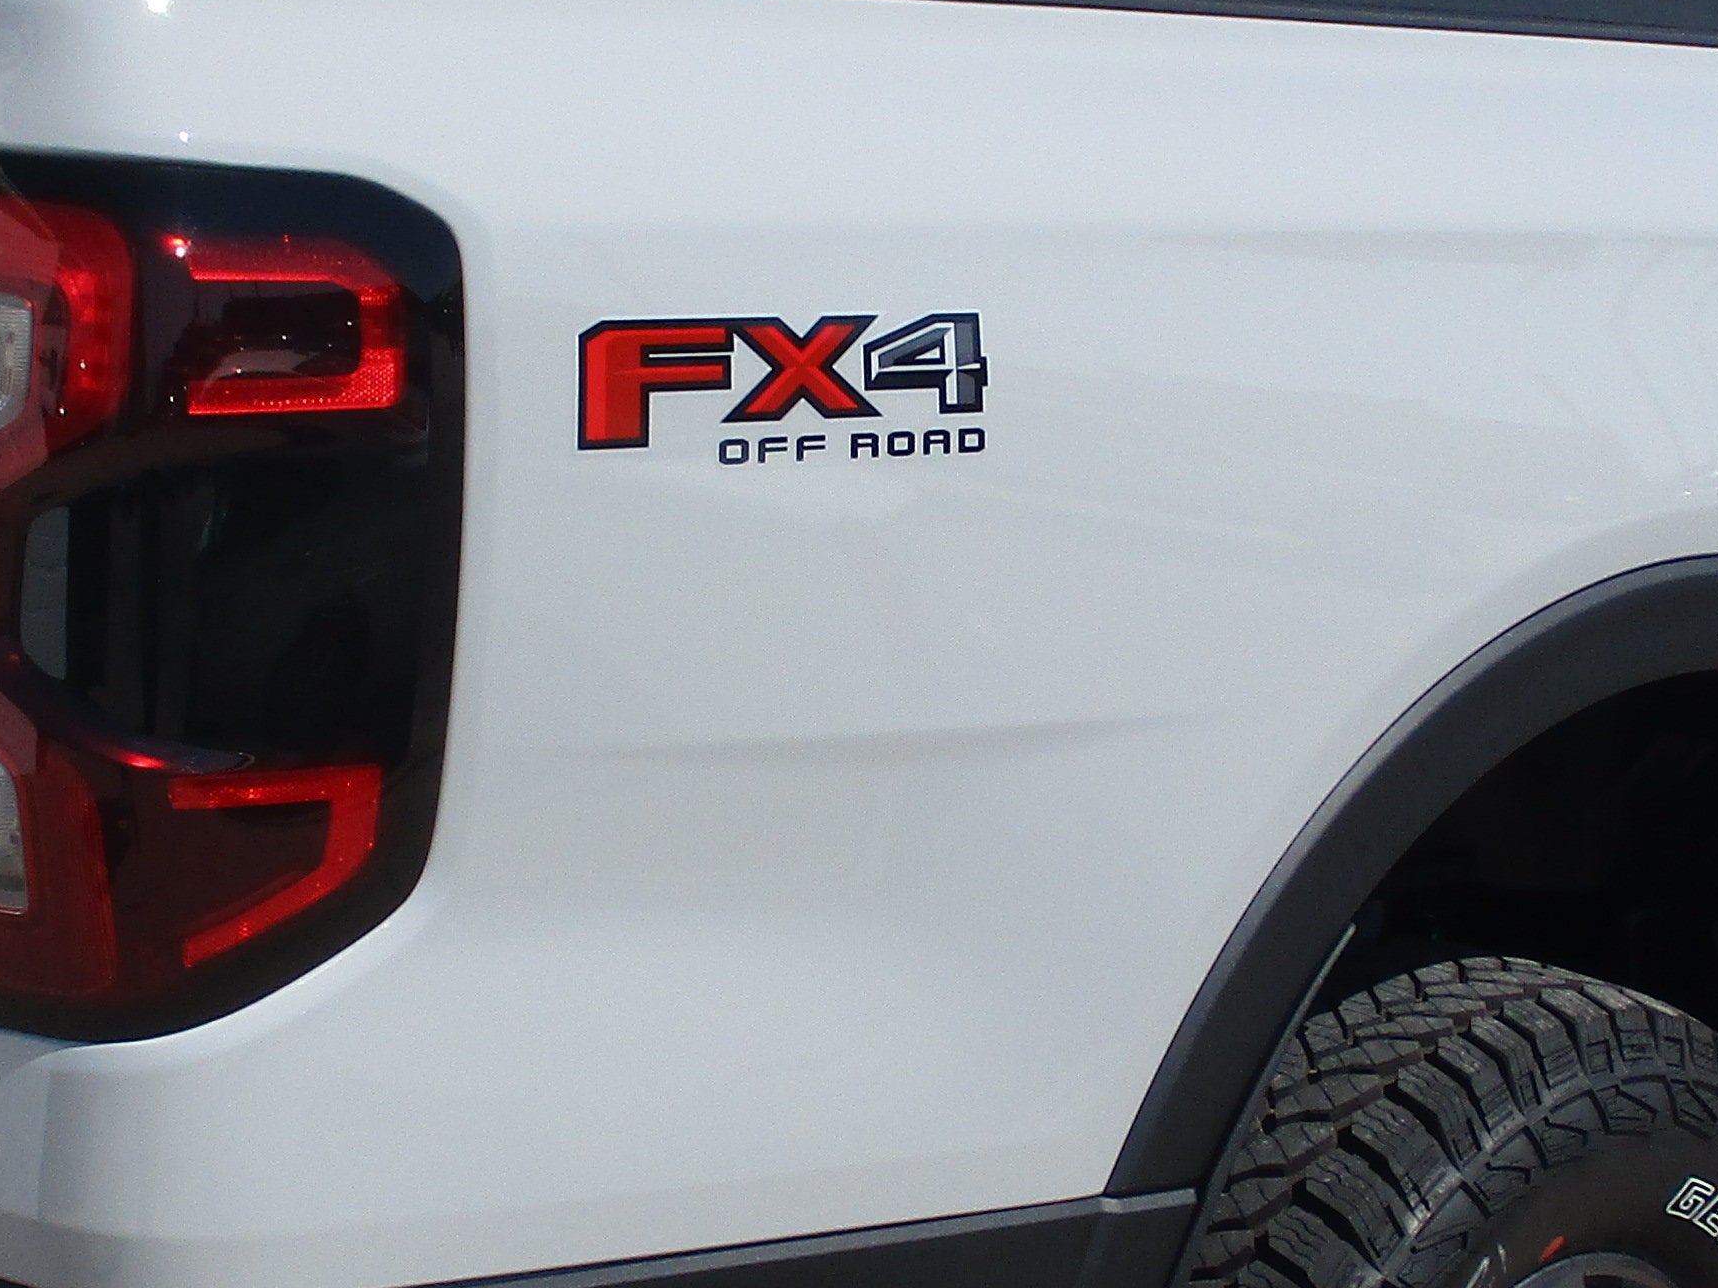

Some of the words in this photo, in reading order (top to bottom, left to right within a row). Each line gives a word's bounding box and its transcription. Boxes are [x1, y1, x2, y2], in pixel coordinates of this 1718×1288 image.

[577, 313, 988, 451] FX4
[718, 434, 827, 466] OFF
[849, 427, 986, 459] ROAD
